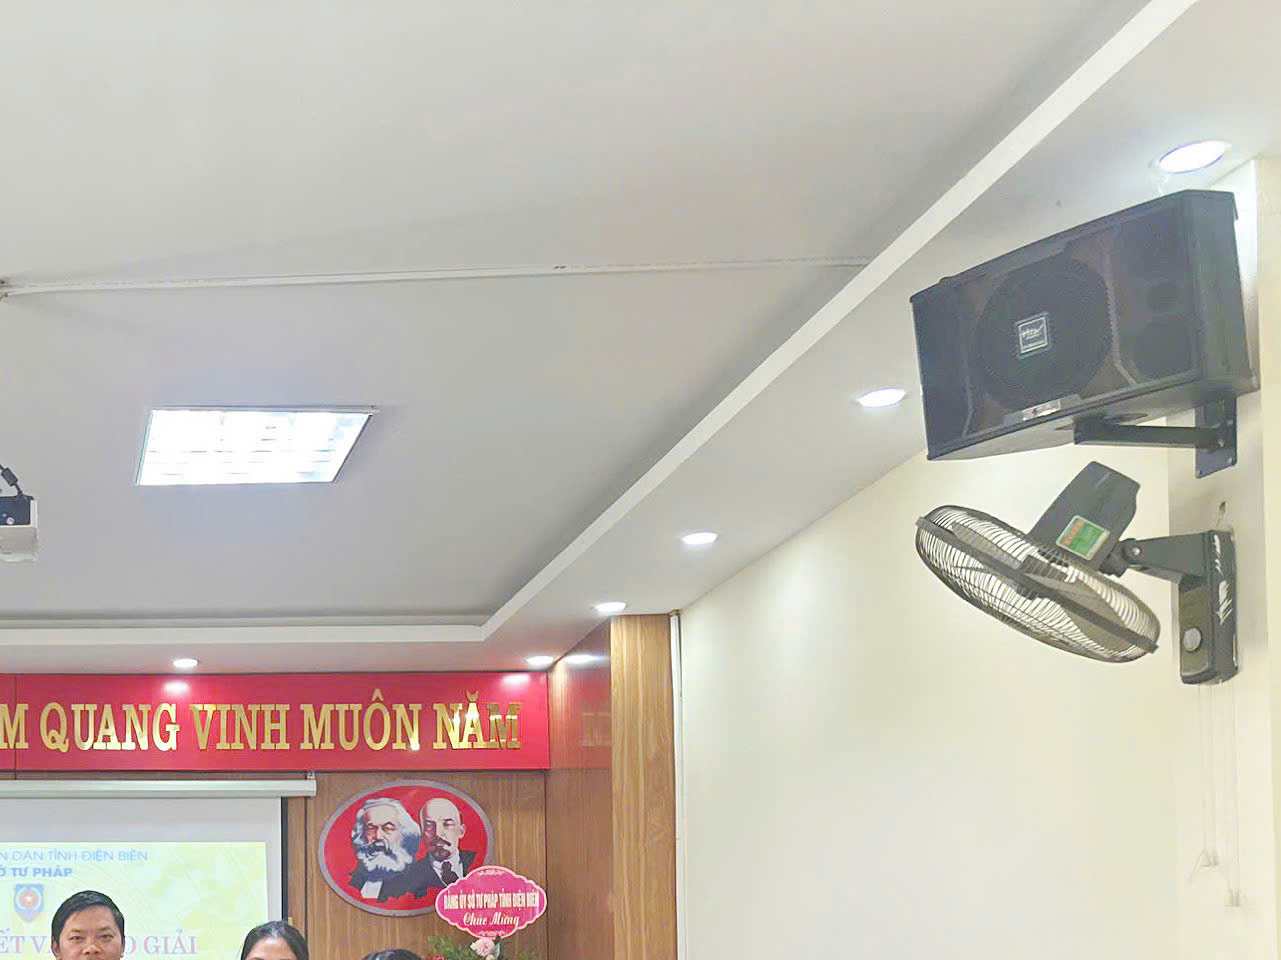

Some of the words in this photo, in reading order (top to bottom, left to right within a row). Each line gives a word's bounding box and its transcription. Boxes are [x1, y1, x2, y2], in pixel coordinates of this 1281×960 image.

[39, 701, 181, 753] QUANG
[189, 702, 291, 752] VINH
[299, 688, 423, 752] MUÔN
[432, 689, 521, 751] NĂM
[11, 866, 29, 877] TƯ
[32, 865, 73, 878] PHÁP
[143, 928, 198, 955] GIẢI
